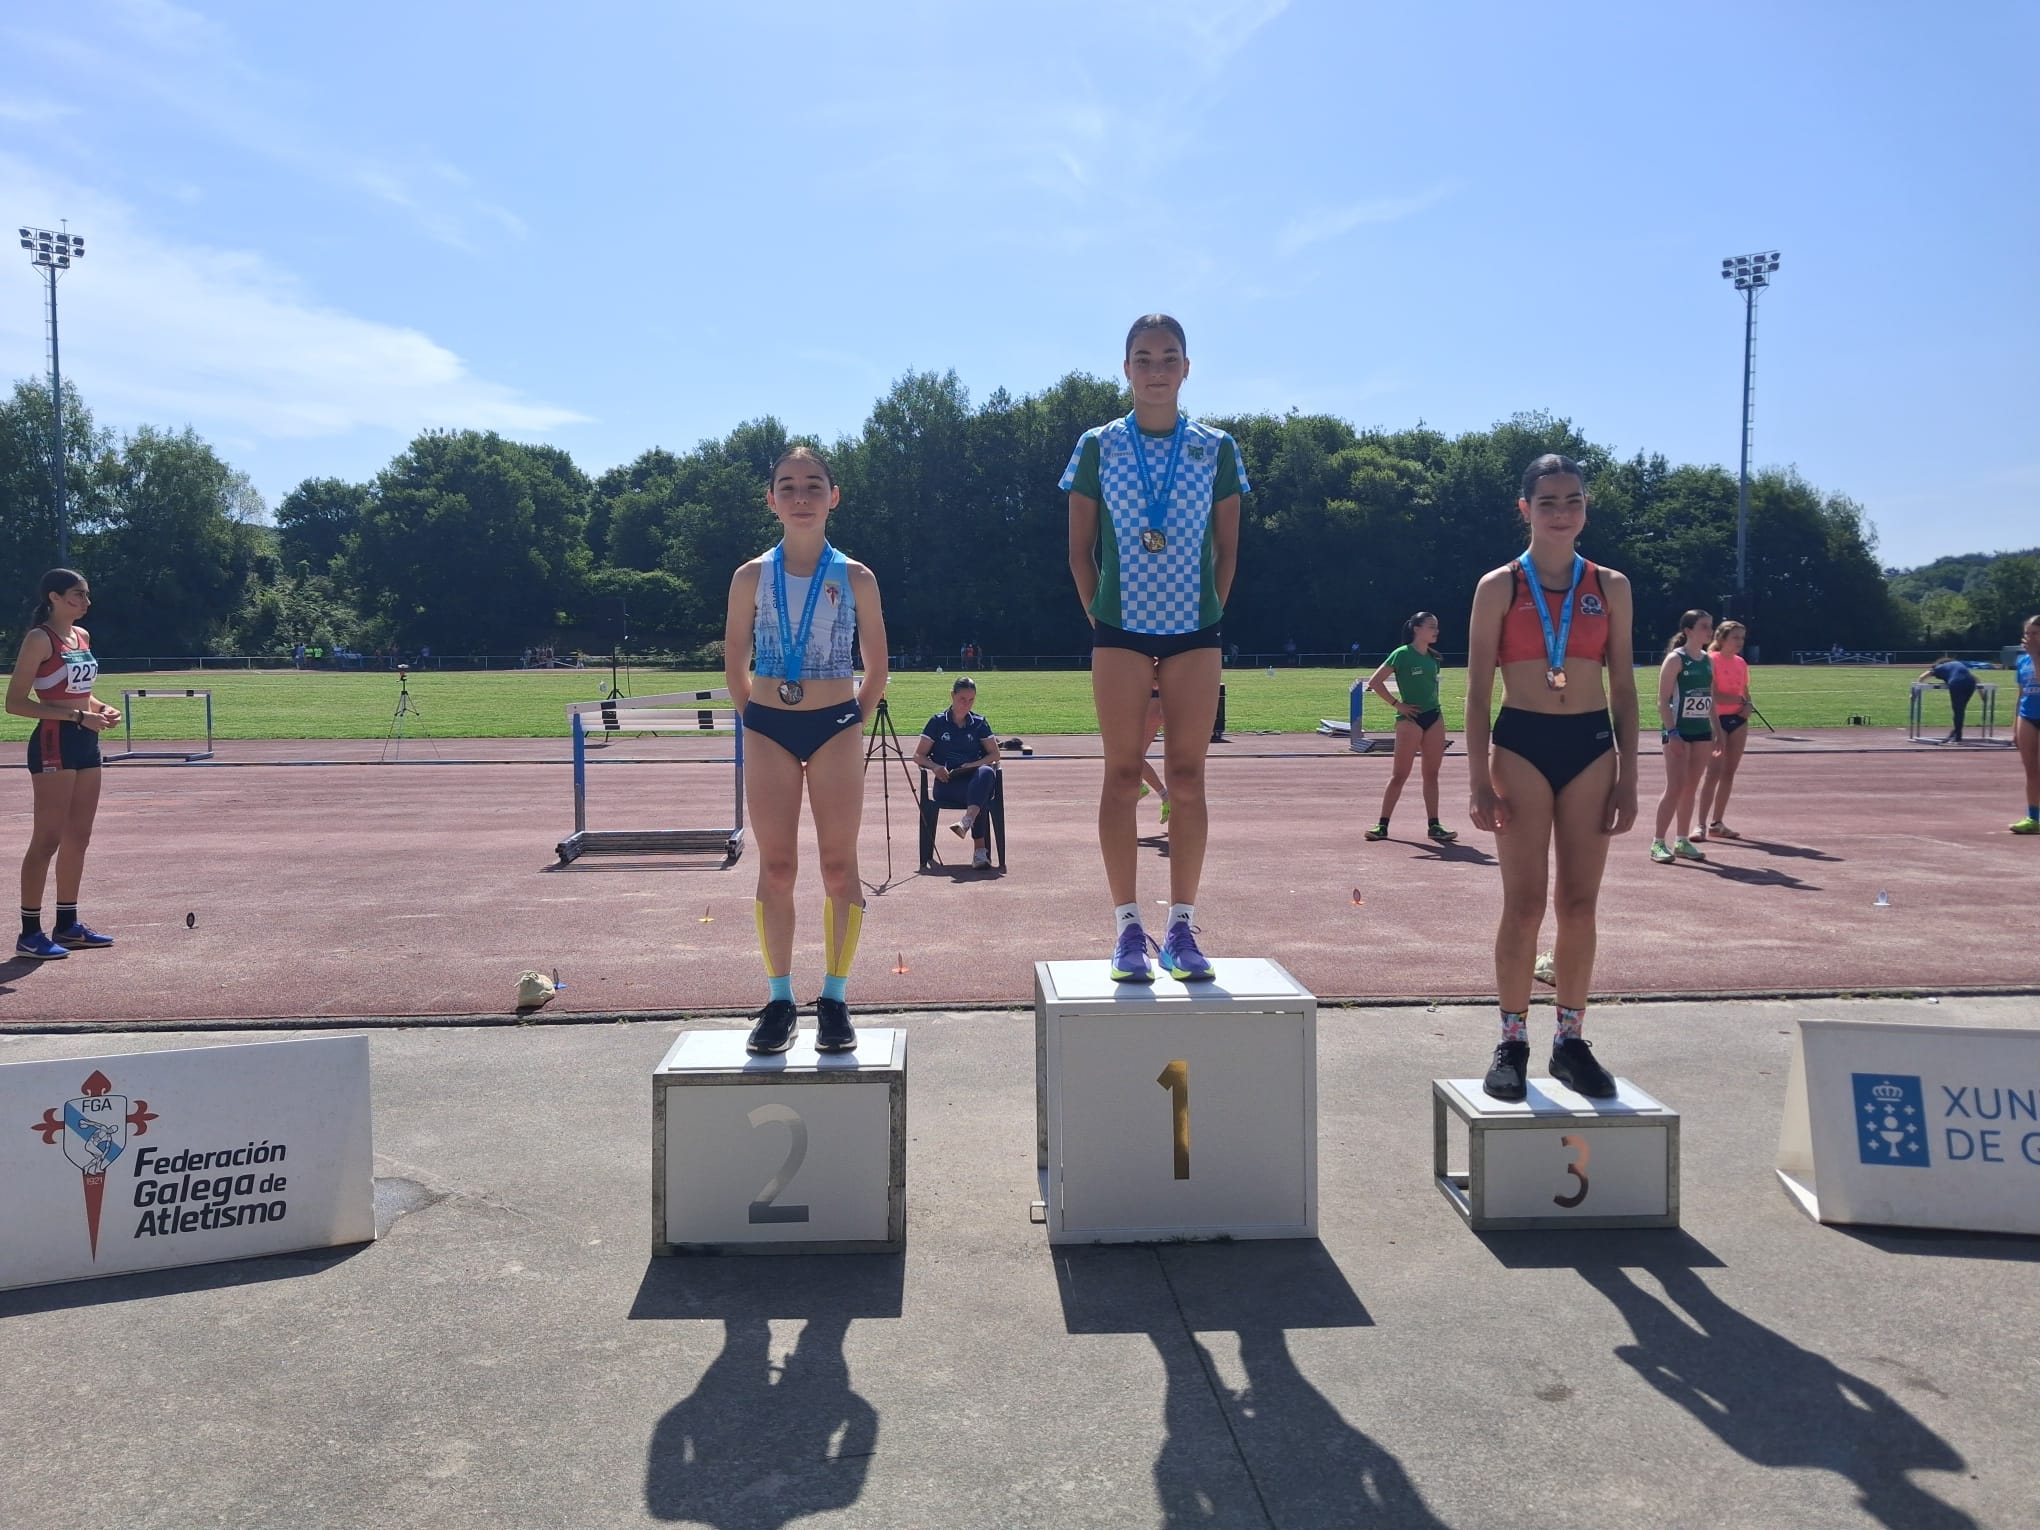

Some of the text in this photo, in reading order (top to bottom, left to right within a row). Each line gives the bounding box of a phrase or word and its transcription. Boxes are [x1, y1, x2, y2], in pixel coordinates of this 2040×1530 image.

[82, 1098, 112, 1113] FGA
[1156, 1059, 1190, 1180] 1
[1941, 1085, 2040, 1121] XUN
[133, 1140, 287, 1178] Federación
[747, 1103, 809, 1224] 2
[1945, 1128, 2004, 1162] DE
[1553, 1134, 1590, 1208] 3
[133, 1173, 287, 1208] Galega de
[133, 1200, 287, 1239] Atletismo
